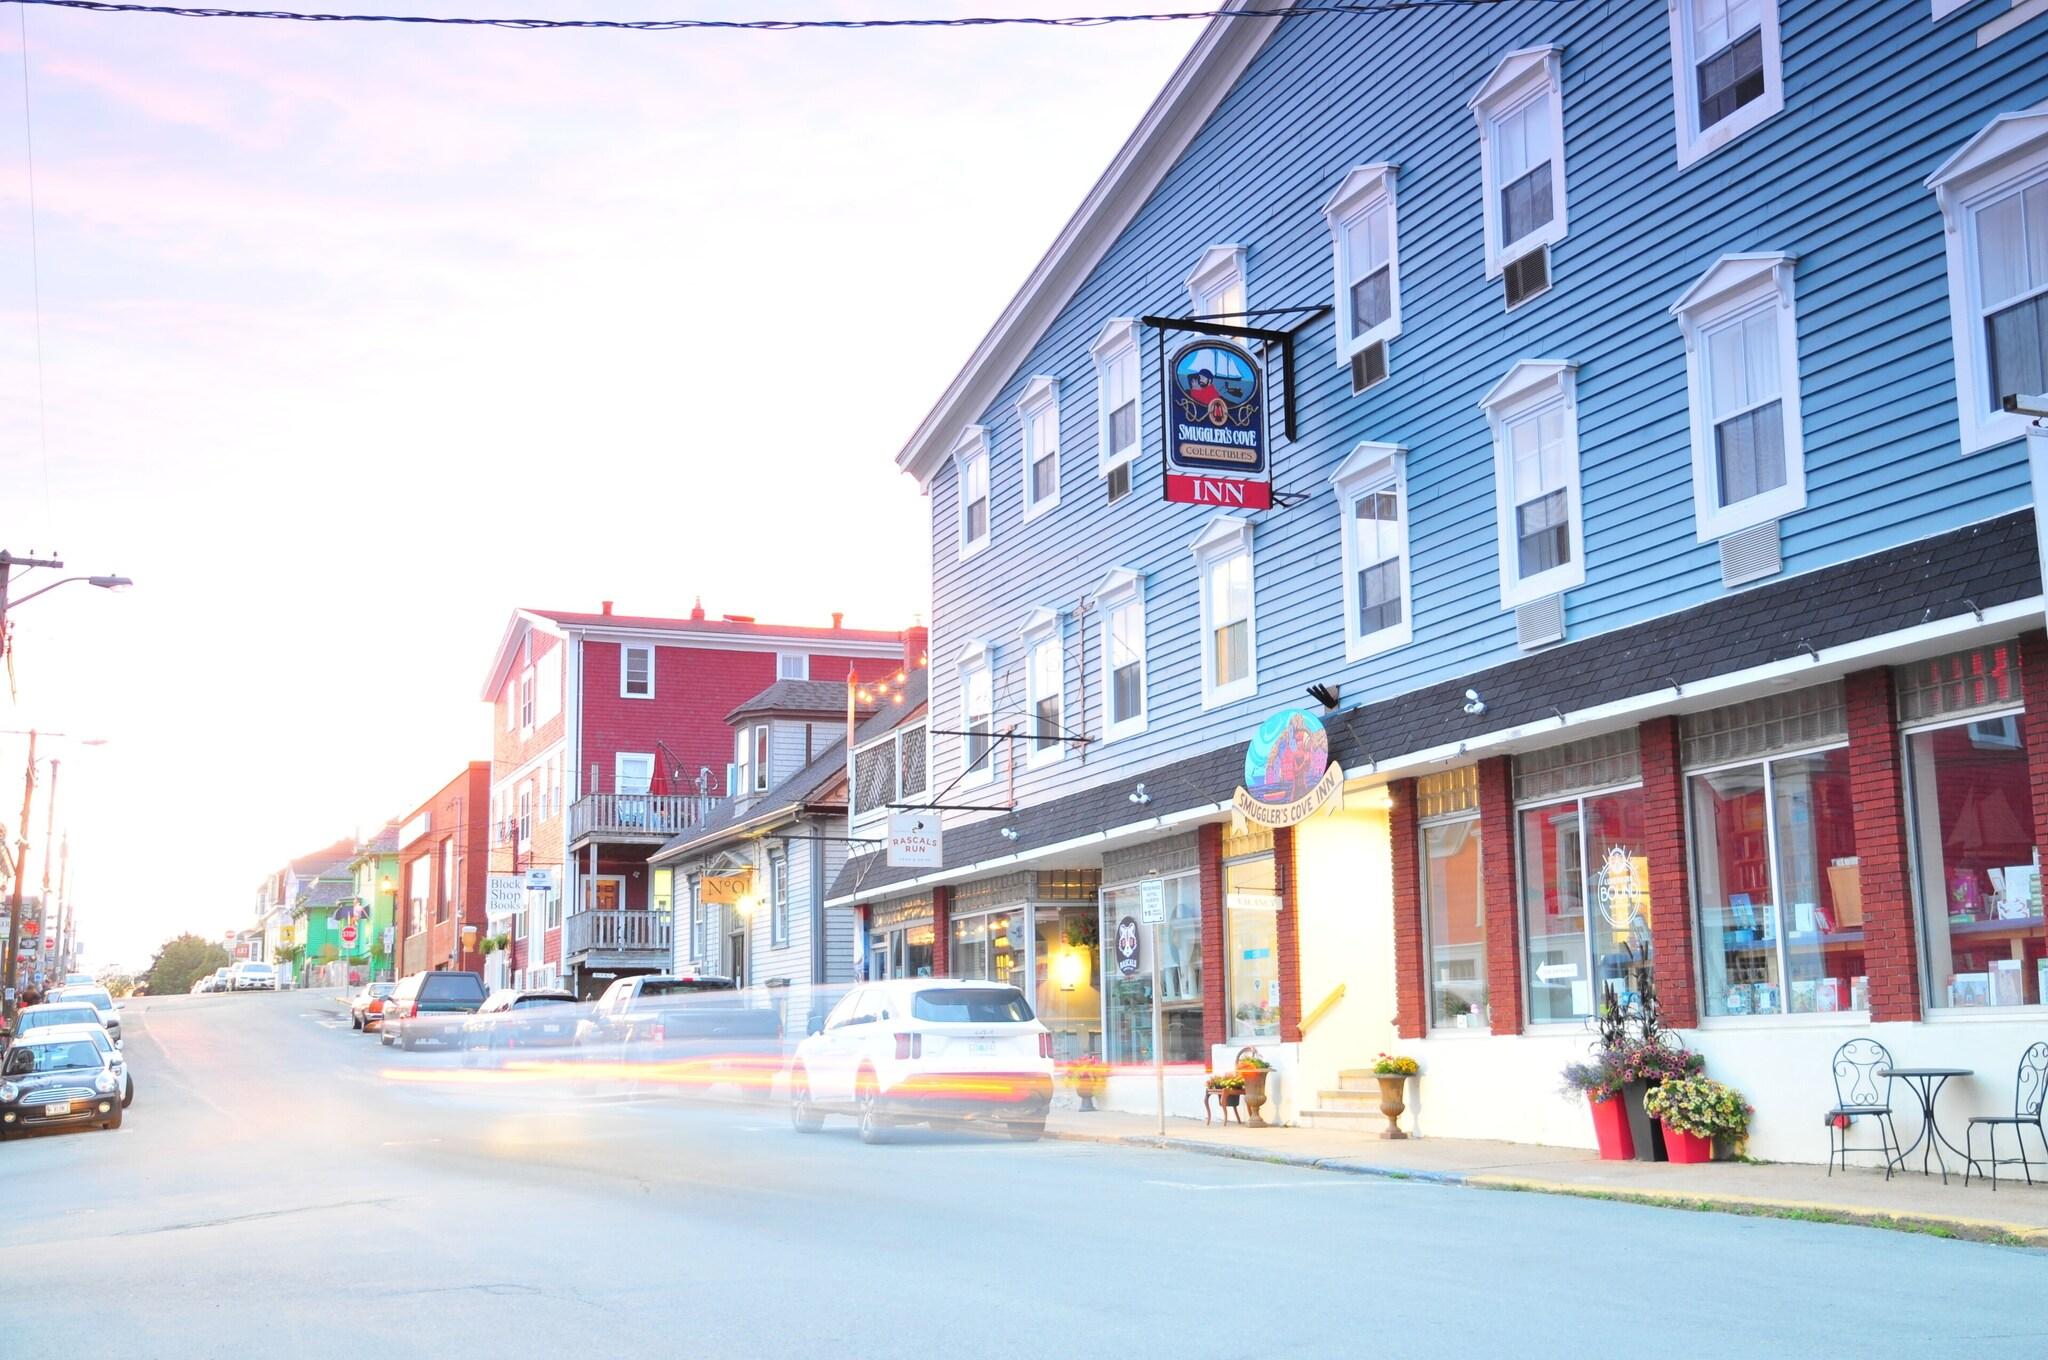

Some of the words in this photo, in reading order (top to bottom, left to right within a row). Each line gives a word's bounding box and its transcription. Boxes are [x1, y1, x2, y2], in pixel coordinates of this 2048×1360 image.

[1179, 424, 1232, 443] SMUGGLER'S
[1233, 429, 1256, 446] COVE
[1186, 447, 1253, 461] COLLECTIBLES
[1193, 480, 1245, 504] INN
[1238, 793, 1288, 824] SMUGGLER'S
[1290, 796, 1313, 821] COVE
[1316, 771, 1335, 804] INN
[893, 836, 937, 847] RASCALS
[491, 879, 521, 889] Block
[491, 889, 521, 903] Shop
[1600, 881, 1639, 902] BOUND
[490, 900, 521, 910] Books
